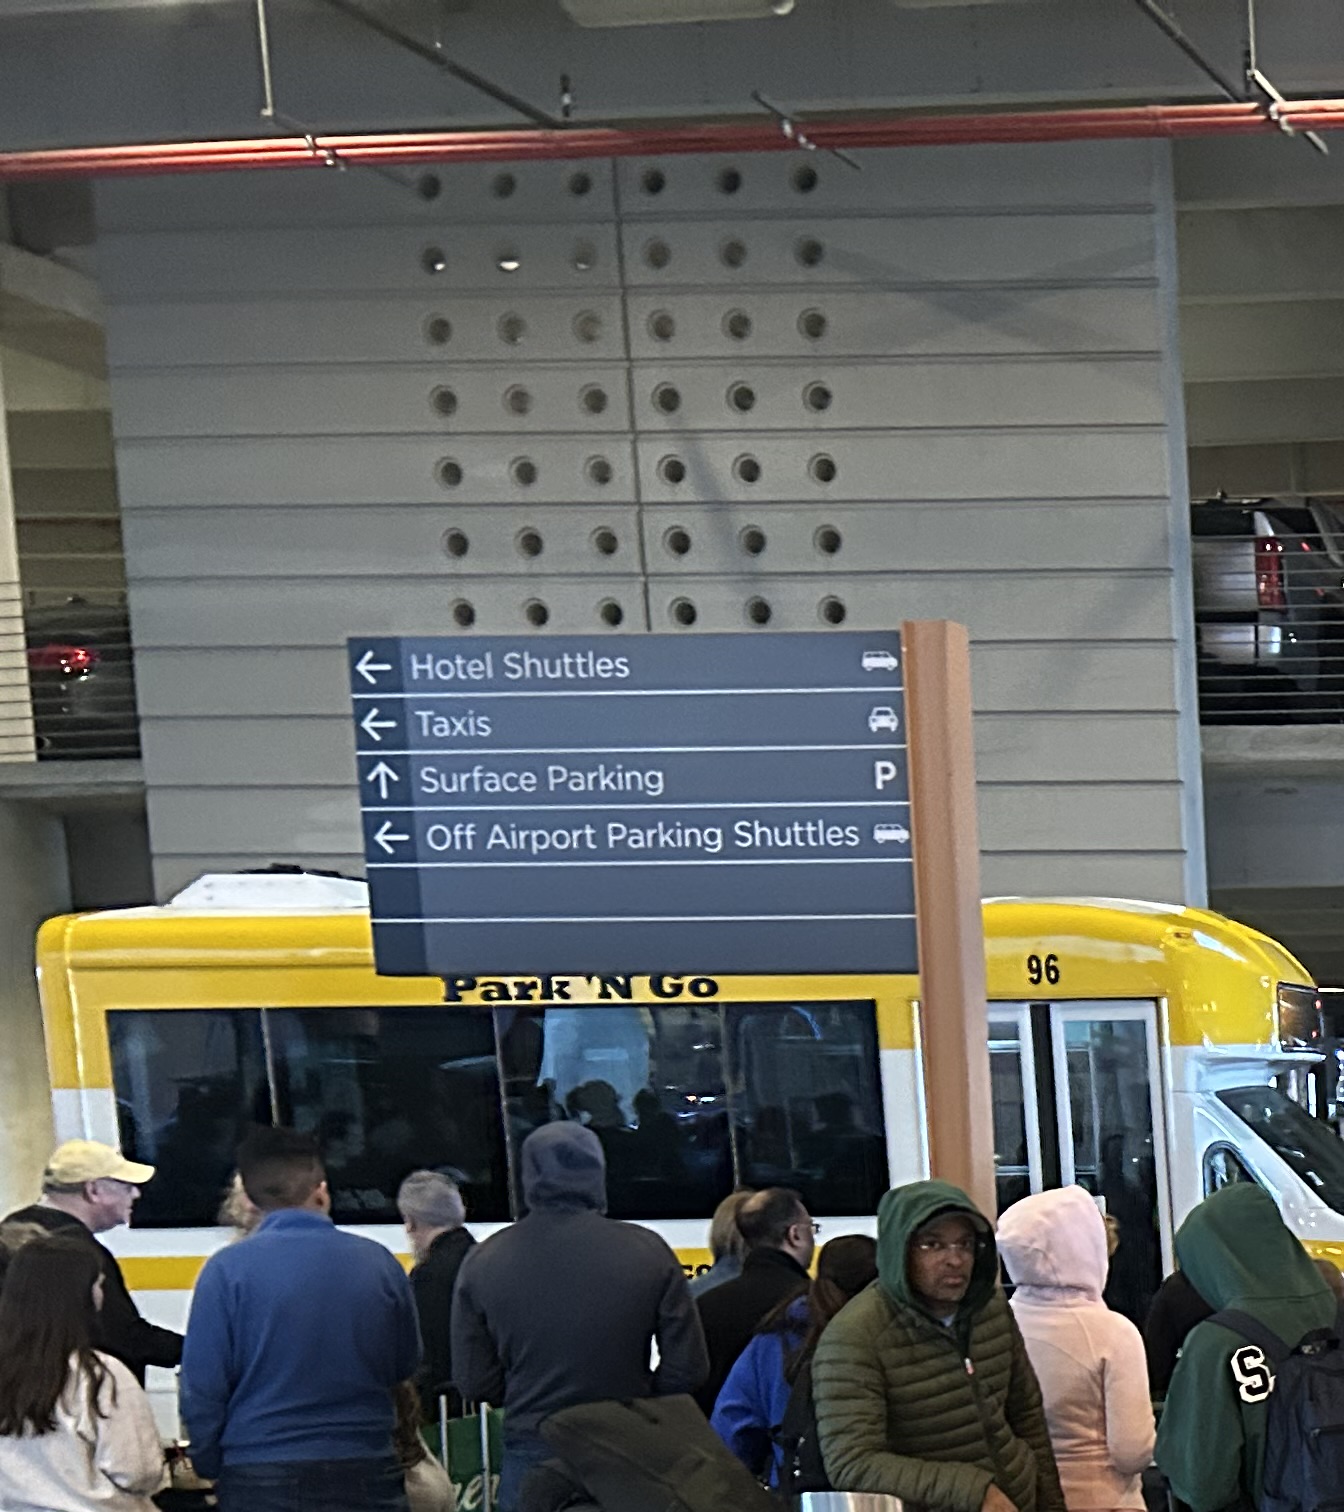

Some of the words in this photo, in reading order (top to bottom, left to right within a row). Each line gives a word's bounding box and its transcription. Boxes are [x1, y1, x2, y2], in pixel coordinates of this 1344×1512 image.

[411, 652, 493, 680] Hotel
[503, 651, 630, 679] Shuttles
[414, 710, 492, 738] Taxis
[420, 765, 537, 794] Surface
[547, 764, 664, 796] Parking
[874, 760, 897, 790] P
[426, 823, 477, 852] Off
[486, 823, 597, 855] Airport
[607, 821, 723, 853] Parking
[734, 819, 860, 848] Shuttles
[1027, 953, 1060, 985] 96
[443, 977, 571, 1002] Park
[649, 976, 719, 999] Go
[1230, 1345, 1271, 1403] S
